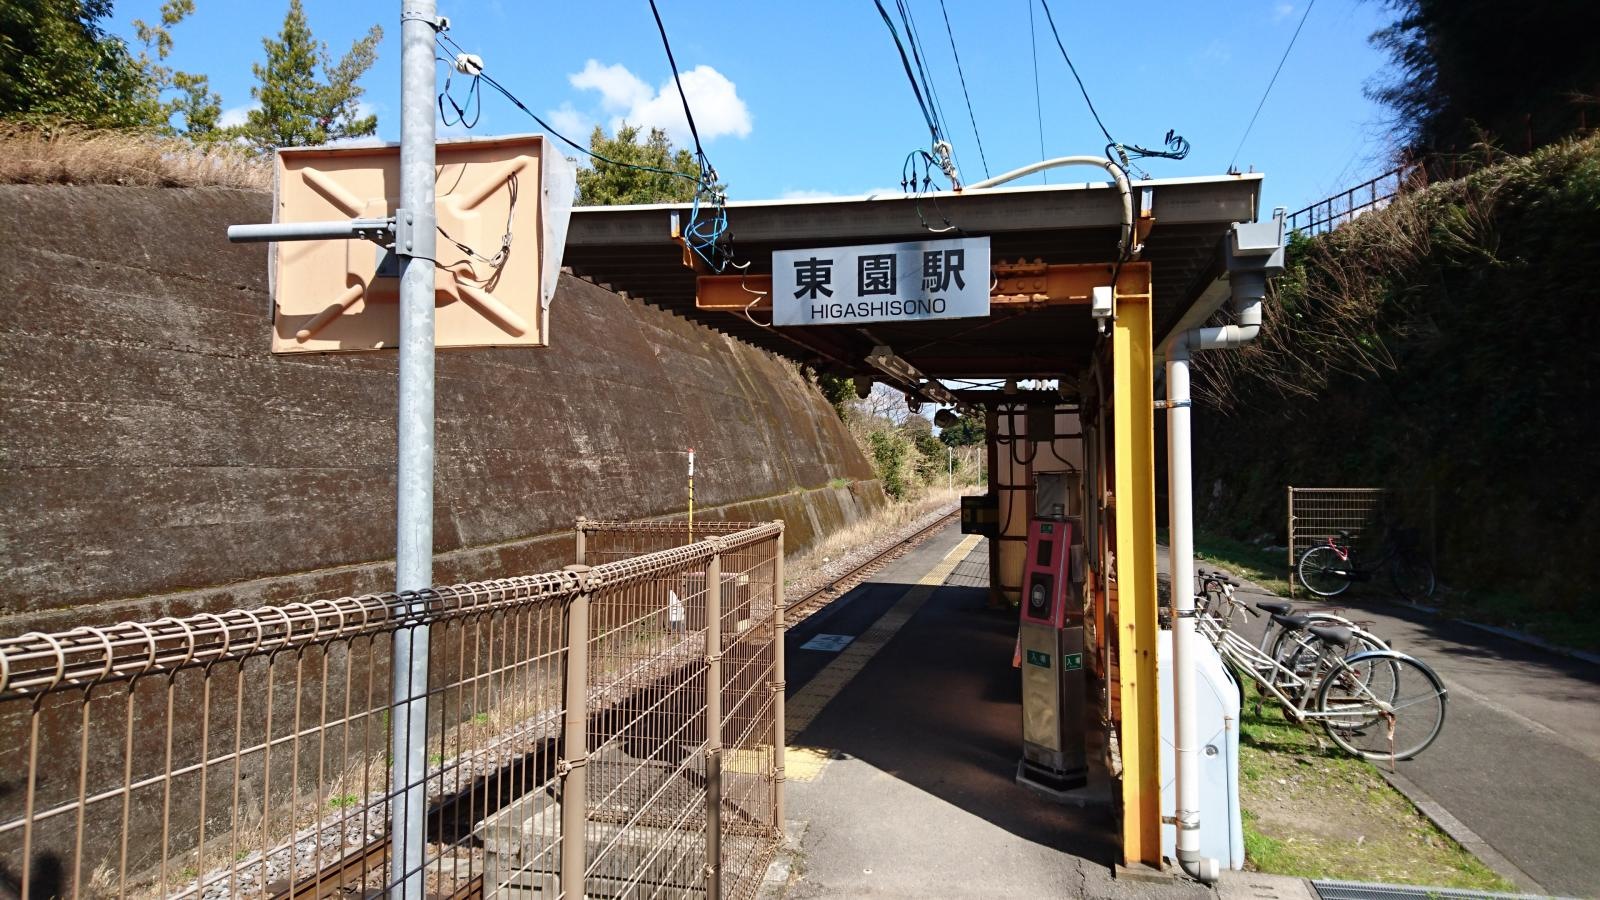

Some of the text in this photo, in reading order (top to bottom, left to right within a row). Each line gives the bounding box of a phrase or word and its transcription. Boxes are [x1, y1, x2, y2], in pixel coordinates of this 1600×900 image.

[793, 248, 966, 300] 東園駅
[811, 298, 946, 319] HIGASHISONO
